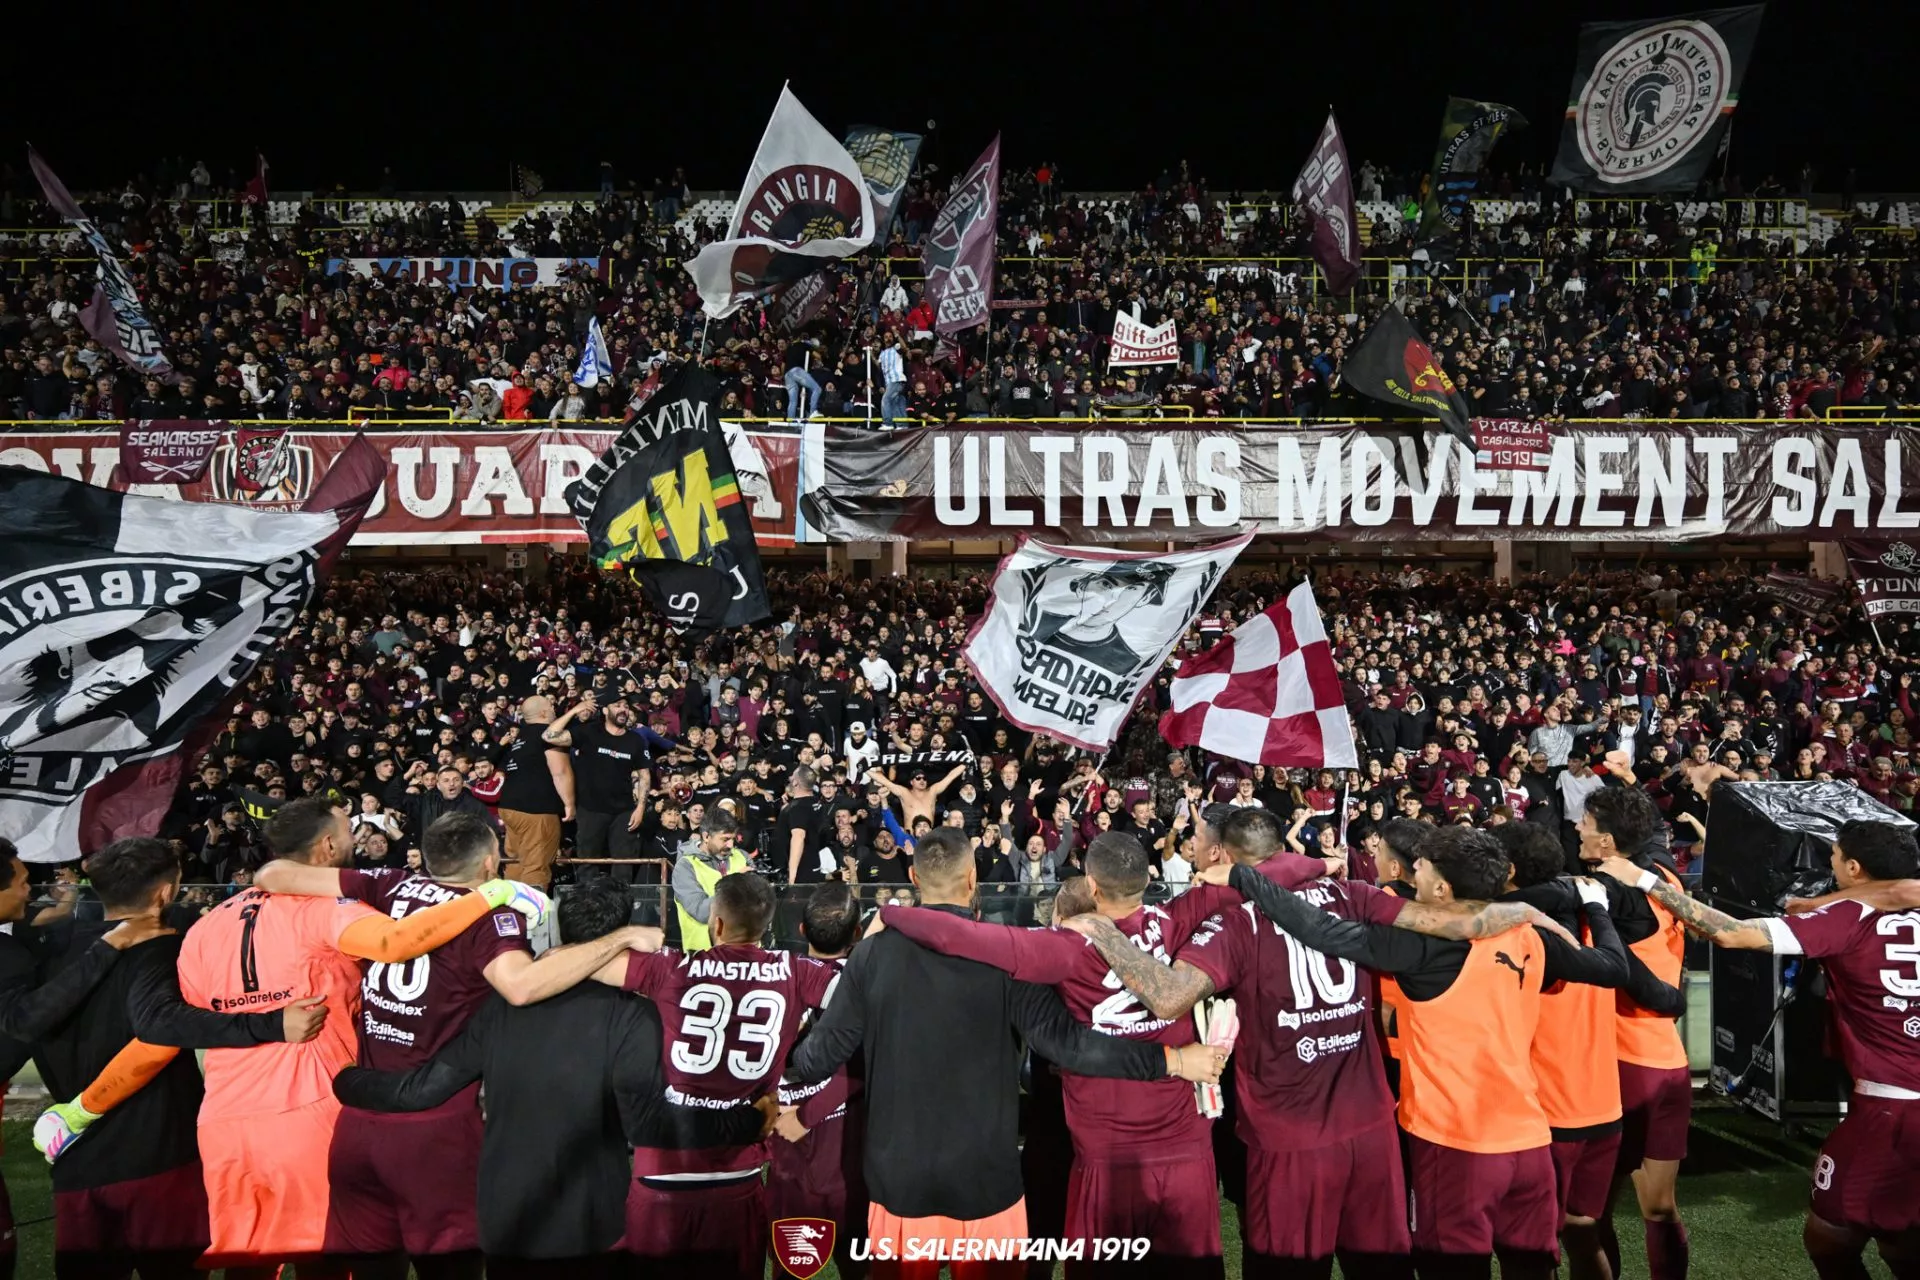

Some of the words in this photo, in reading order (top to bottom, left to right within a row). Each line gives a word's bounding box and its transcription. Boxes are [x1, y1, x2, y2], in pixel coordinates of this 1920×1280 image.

[1440, 130, 1470, 174] ULTRAS
[745, 172, 837, 239] RANGIA
[371, 259, 539, 285] VIKING
[1115, 321, 1176, 345] giffoni
[1111, 344, 1177, 361] granata
[127, 431, 221, 447] SEAHORSES
[1479, 420, 1544, 434] PIAZZA
[143, 447, 204, 458] SALERNO
[1482, 436, 1544, 448] CASALBORE
[1494, 450, 1531, 465] 1919
[934, 436, 1241, 527] ULTRAS
[1277, 436, 1739, 527] MOVEMENT
[1772, 438, 1920, 528] SAL
[868, 750, 975, 766] PASTENA
[239, 904, 262, 993] 1
[1274, 911, 1356, 1010] 10
[1301, 997, 1365, 1025] isolareflex
[372, 1020, 415, 1041] Edilcasa
[670, 982, 787, 1080] 33
[1814, 1154, 1835, 1191] 8
